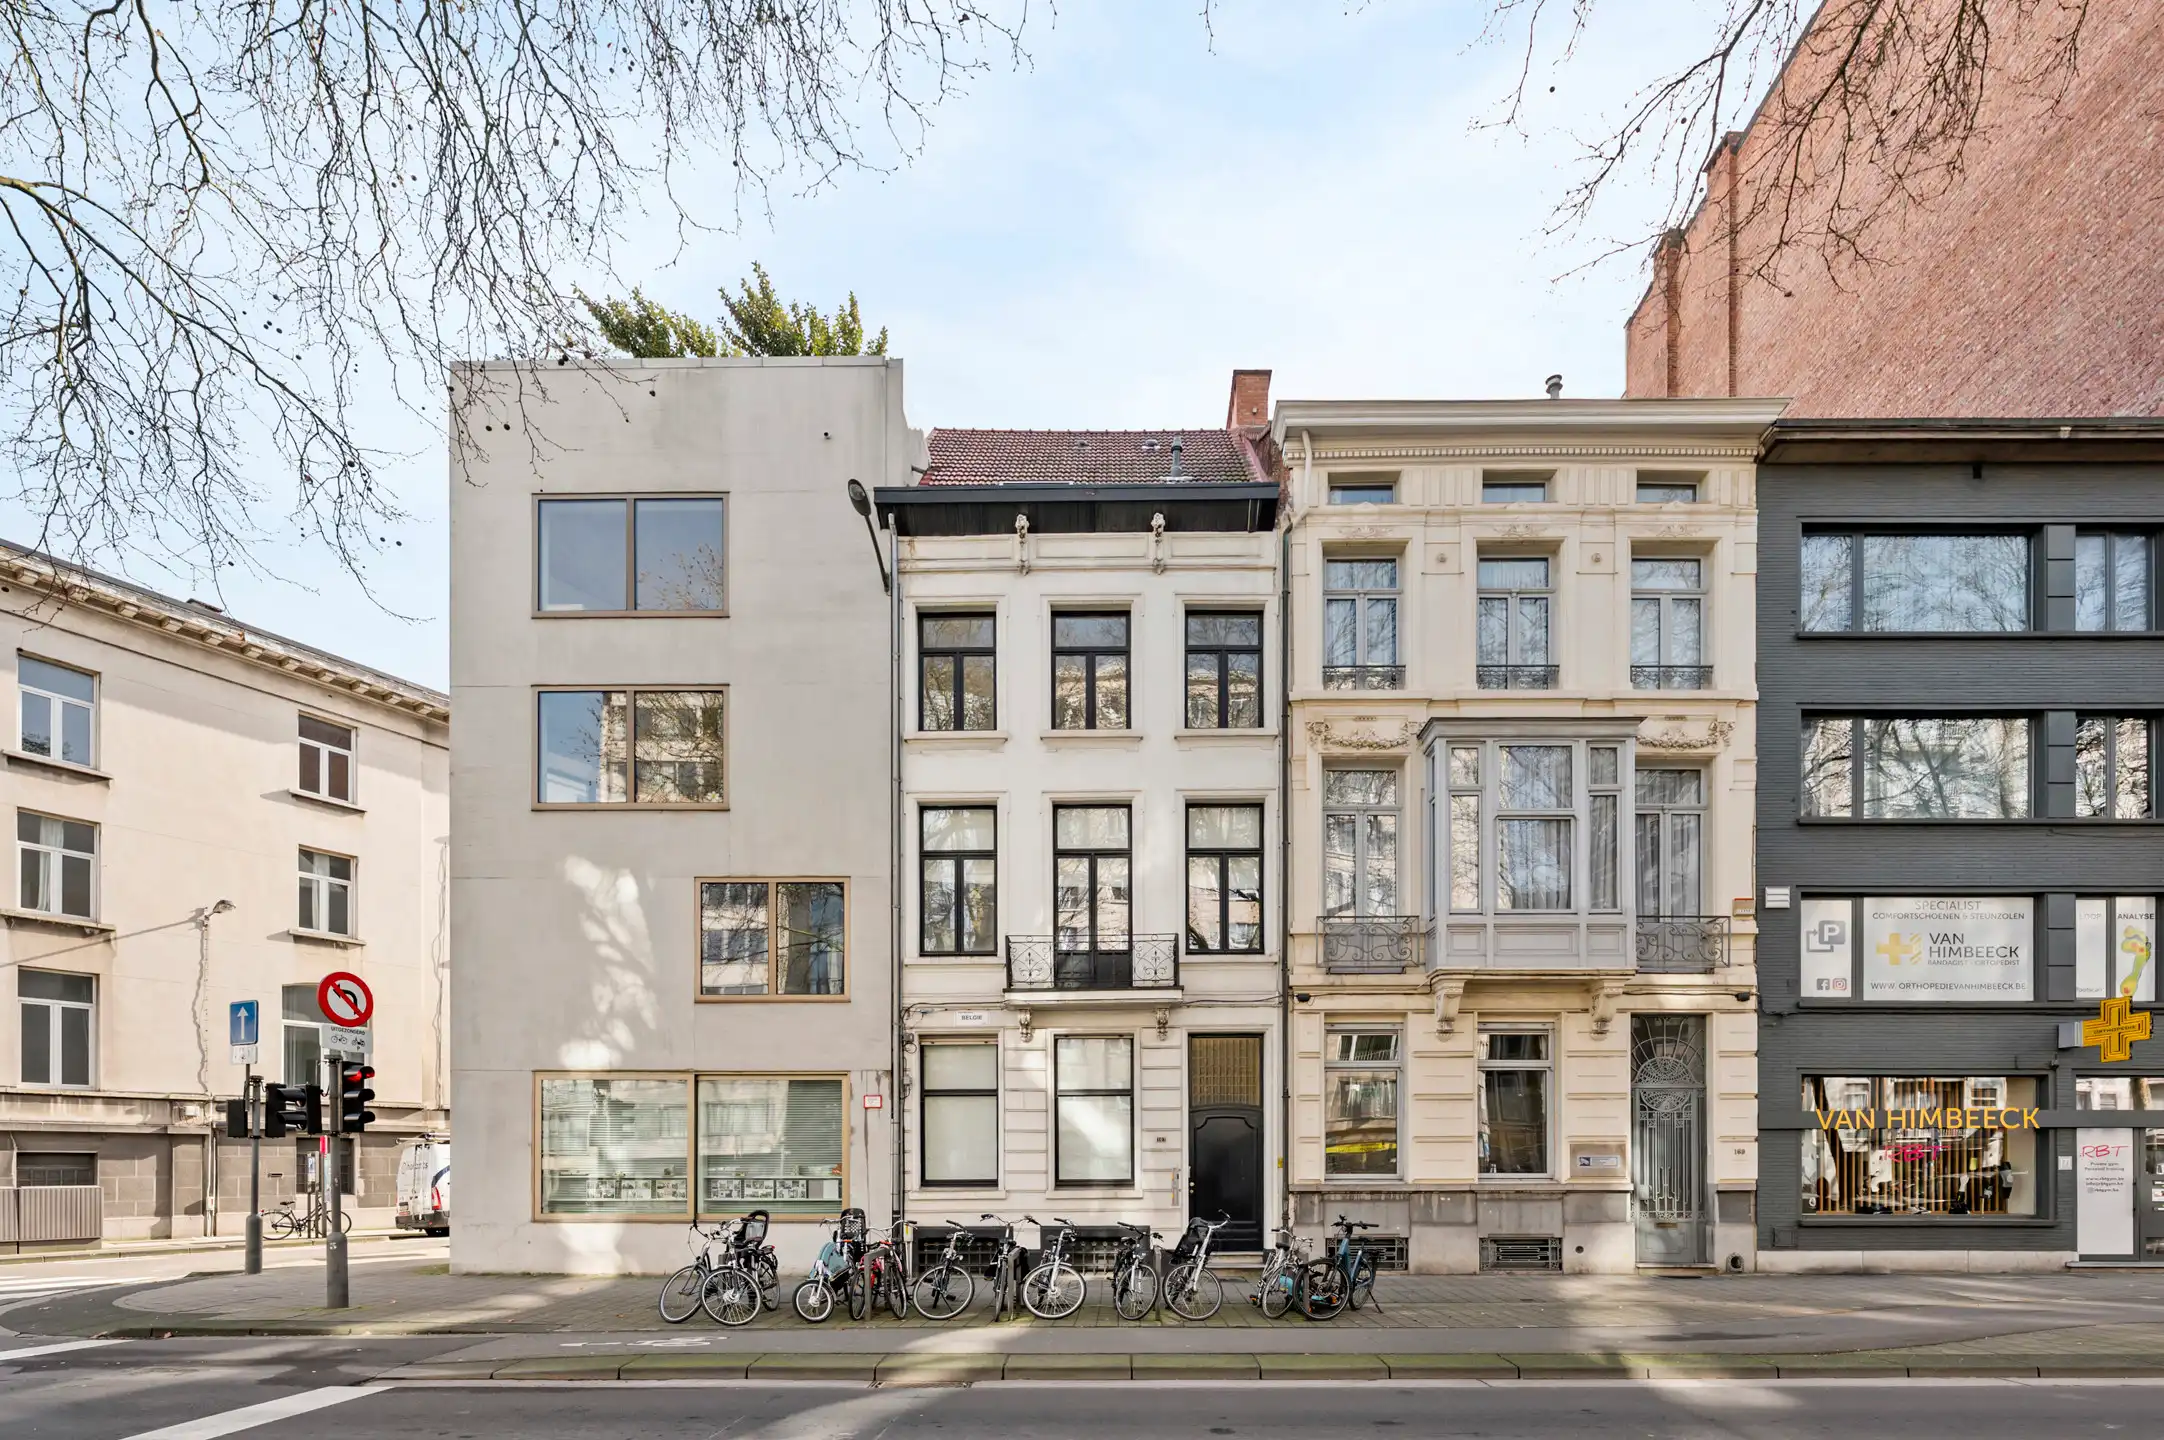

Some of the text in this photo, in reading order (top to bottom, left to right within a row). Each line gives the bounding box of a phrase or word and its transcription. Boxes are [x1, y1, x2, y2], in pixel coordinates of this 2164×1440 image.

[1915, 900, 1982, 911] SPECIALIST
[1872, 912, 1960, 920] COMFORTSCHOENEN
[1970, 912, 2025, 920] STEUNZOLEN
[1928, 932, 1965, 945] VAN
[1929, 946, 2020, 958] HIMBEECK
[1816, 1107, 2041, 1130] VAN HIMBEECK
[1884, 1143, 1952, 1163] RBT
[2080, 1144, 2130, 1159] RBT
